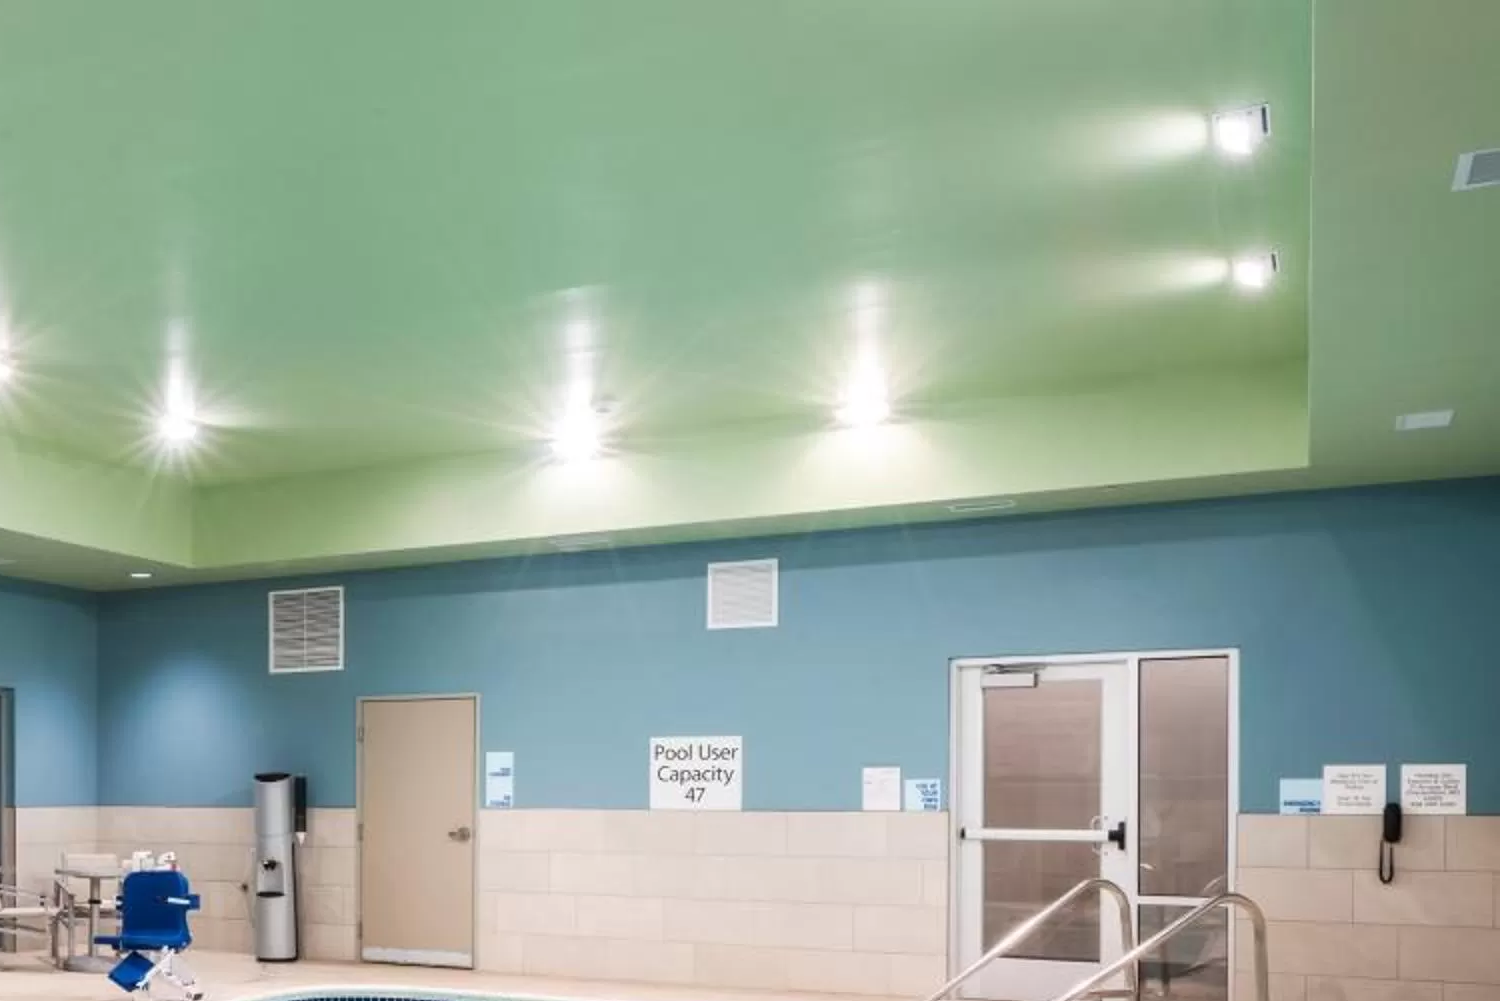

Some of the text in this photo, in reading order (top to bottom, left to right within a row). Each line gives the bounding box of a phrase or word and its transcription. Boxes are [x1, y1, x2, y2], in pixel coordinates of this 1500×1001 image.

[654, 743, 739, 761] Pool User
[657, 765, 735, 786] Capacity
[684, 786, 706, 803] 47
